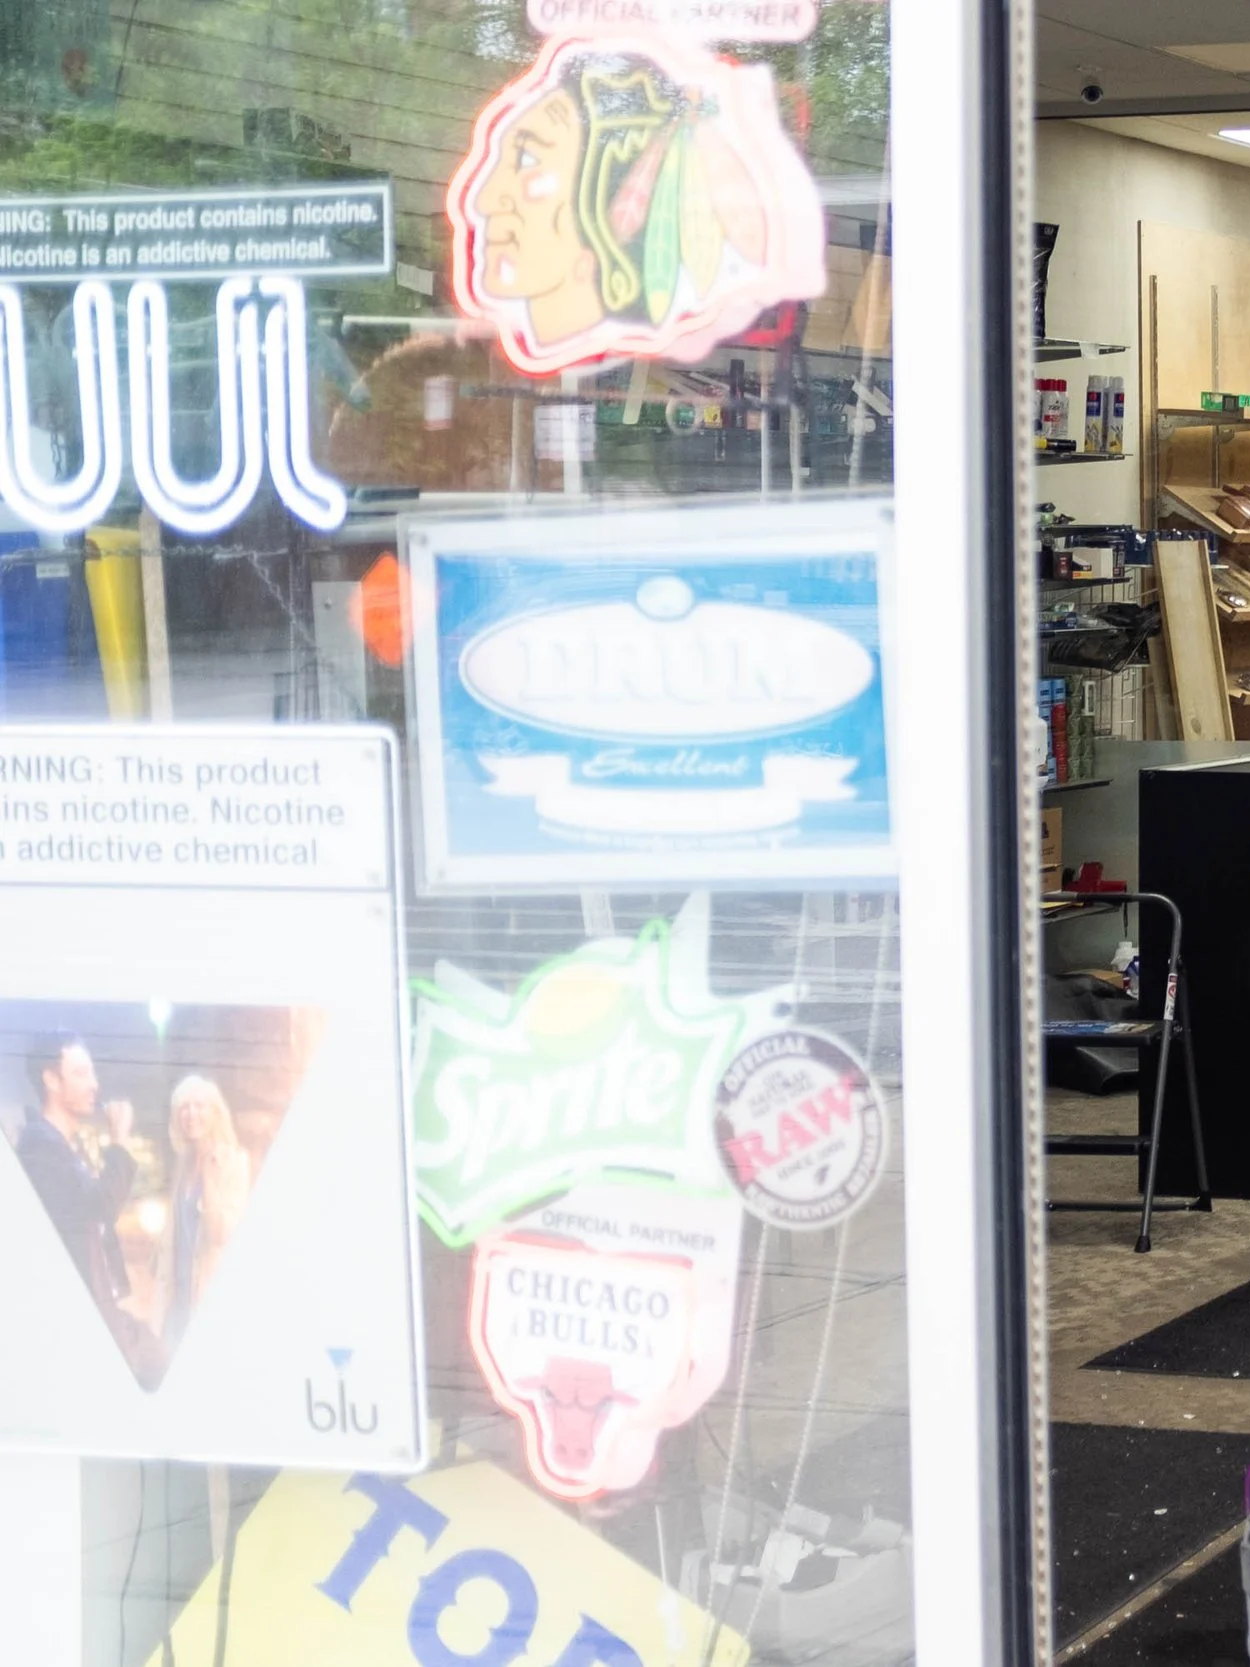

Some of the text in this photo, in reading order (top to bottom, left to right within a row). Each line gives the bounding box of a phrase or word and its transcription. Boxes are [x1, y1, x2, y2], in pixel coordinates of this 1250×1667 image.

[669, 2, 799, 26] ARNER
[63, 208, 108, 232] This
[114, 206, 194, 236] product
[200, 204, 287, 229] contains
[293, 201, 377, 224] nicotine.
[82, 242, 99, 266] is
[106, 246, 131, 265] an
[137, 239, 230, 264] addictive
[235, 236, 331, 261] chemical.
[116, 755, 183, 785] This
[196, 757, 322, 791] product
[581, 747, 750, 778] Excellent
[62, 794, 198, 825] nicotine.
[211, 796, 345, 827] Nicotine
[18, 832, 163, 864] addictive
[174, 836, 319, 867] chemical
[724, 1035, 811, 1092] OFFICIAL
[415, 1026, 685, 1184] Sprite
[724, 1068, 858, 1187] RAW
[541, 1210, 716, 1251] OFFICIAL PARTNER
[507, 1268, 670, 1319] CHICAGO
[528, 1308, 639, 1353] BULLS
[306, 1378, 378, 1434] blu
